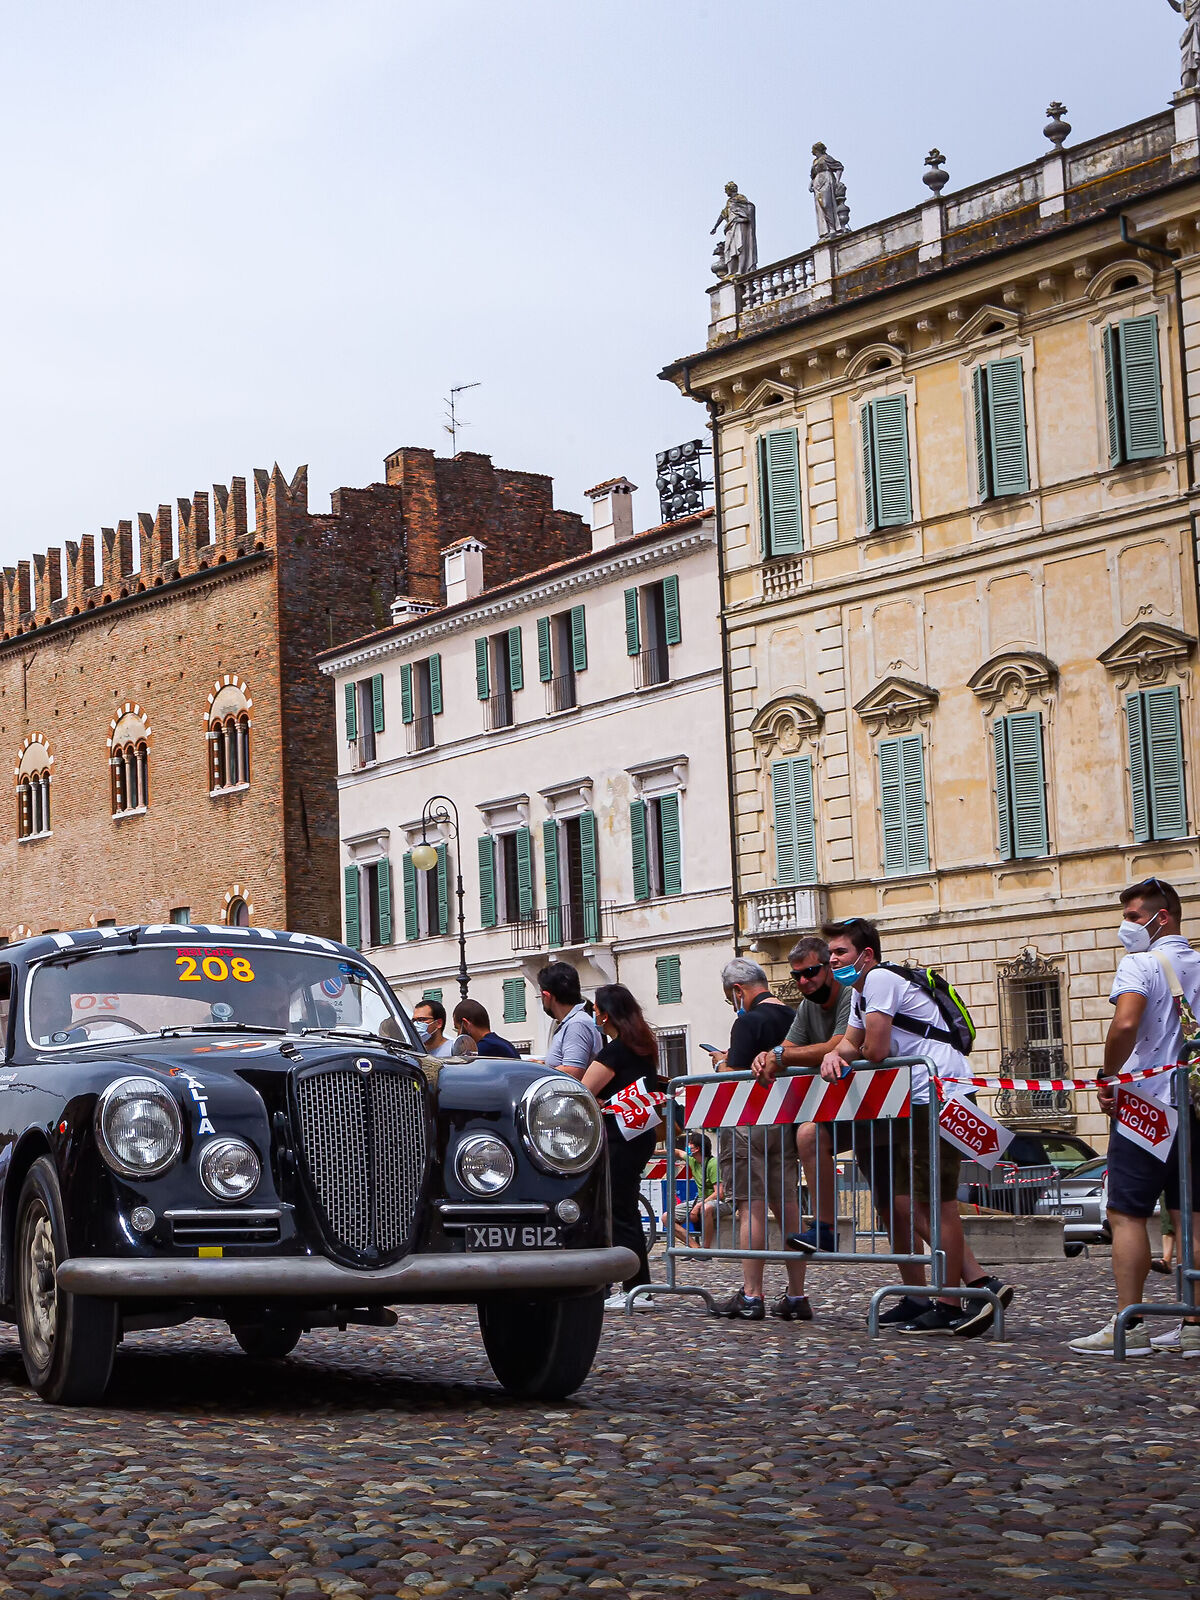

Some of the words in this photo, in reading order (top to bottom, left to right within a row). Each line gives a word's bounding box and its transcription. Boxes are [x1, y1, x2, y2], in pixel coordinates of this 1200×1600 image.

[175, 956, 255, 982] 208
[618, 1090, 634, 1124] MIIA
[628, 1084, 644, 1115] 100
[1124, 1094, 1159, 1122] 1000
[940, 1116, 983, 1150] MIGLIA
[952, 1106, 988, 1136] 1000
[1119, 1106, 1157, 1140] MIGLIA
[474, 1228, 516, 1246] XBV
[522, 1226, 557, 1246] 612
